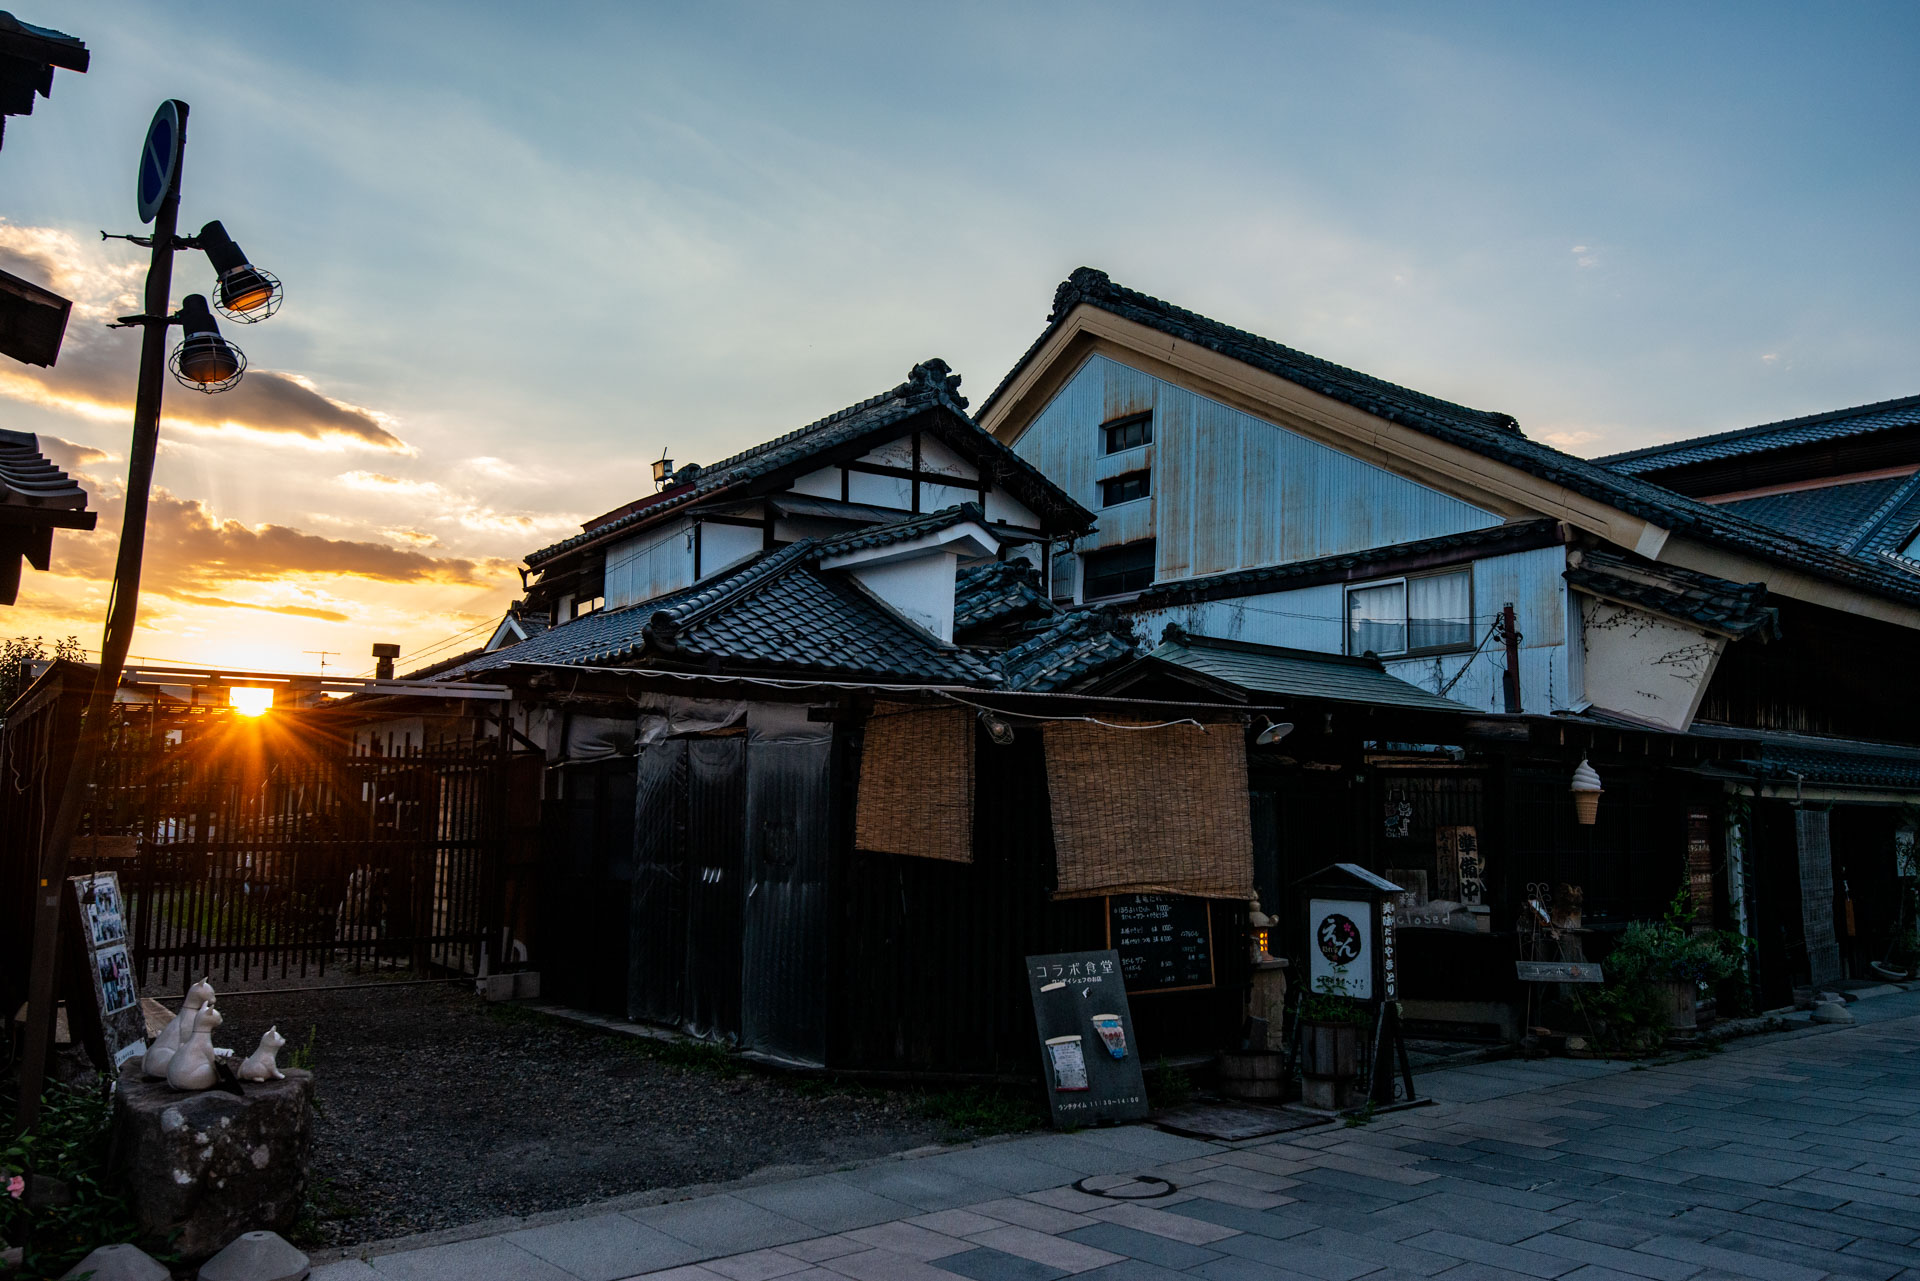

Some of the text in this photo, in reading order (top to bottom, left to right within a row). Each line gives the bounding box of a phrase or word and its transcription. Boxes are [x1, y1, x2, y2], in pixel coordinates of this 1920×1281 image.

[1459, 832, 1480, 902] 準備中
[1322, 918, 1358, 958] えん
[1382, 901, 1396, 996] 美味だれやきとり
[1036, 960, 1115, 977] コラボ食堂
